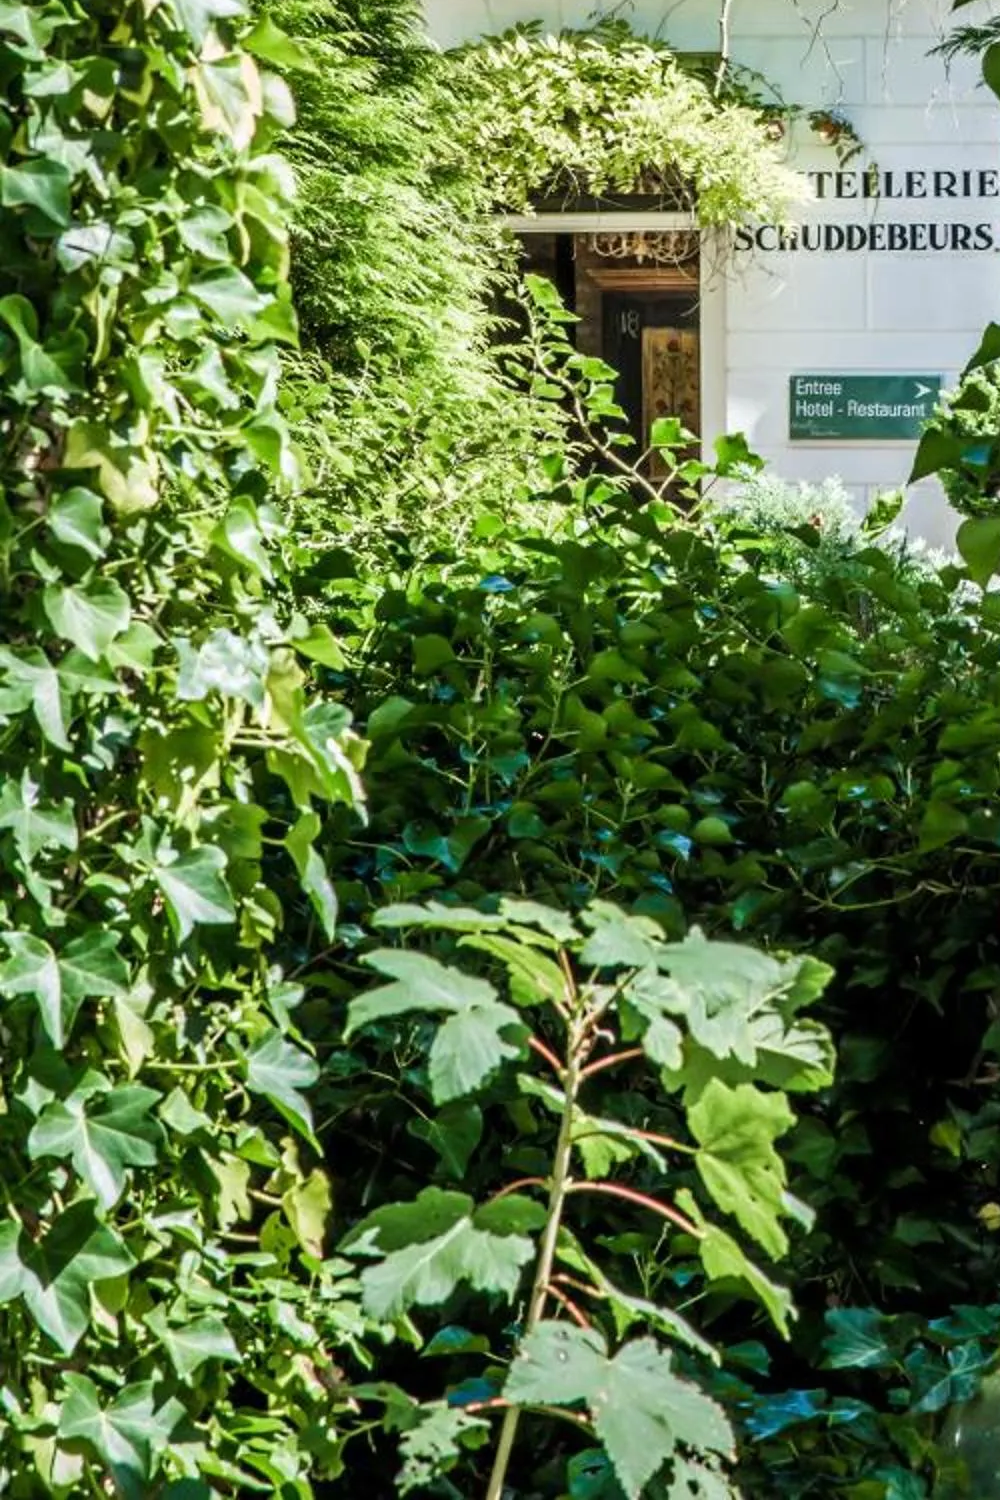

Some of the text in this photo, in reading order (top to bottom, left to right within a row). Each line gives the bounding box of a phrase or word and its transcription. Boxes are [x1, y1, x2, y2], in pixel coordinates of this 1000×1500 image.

[797, 171, 999, 198] TELLERIE
[796, 379, 842, 395] Entree
[796, 400, 833, 417] Hotel
[847, 399, 925, 417] Restaurant
